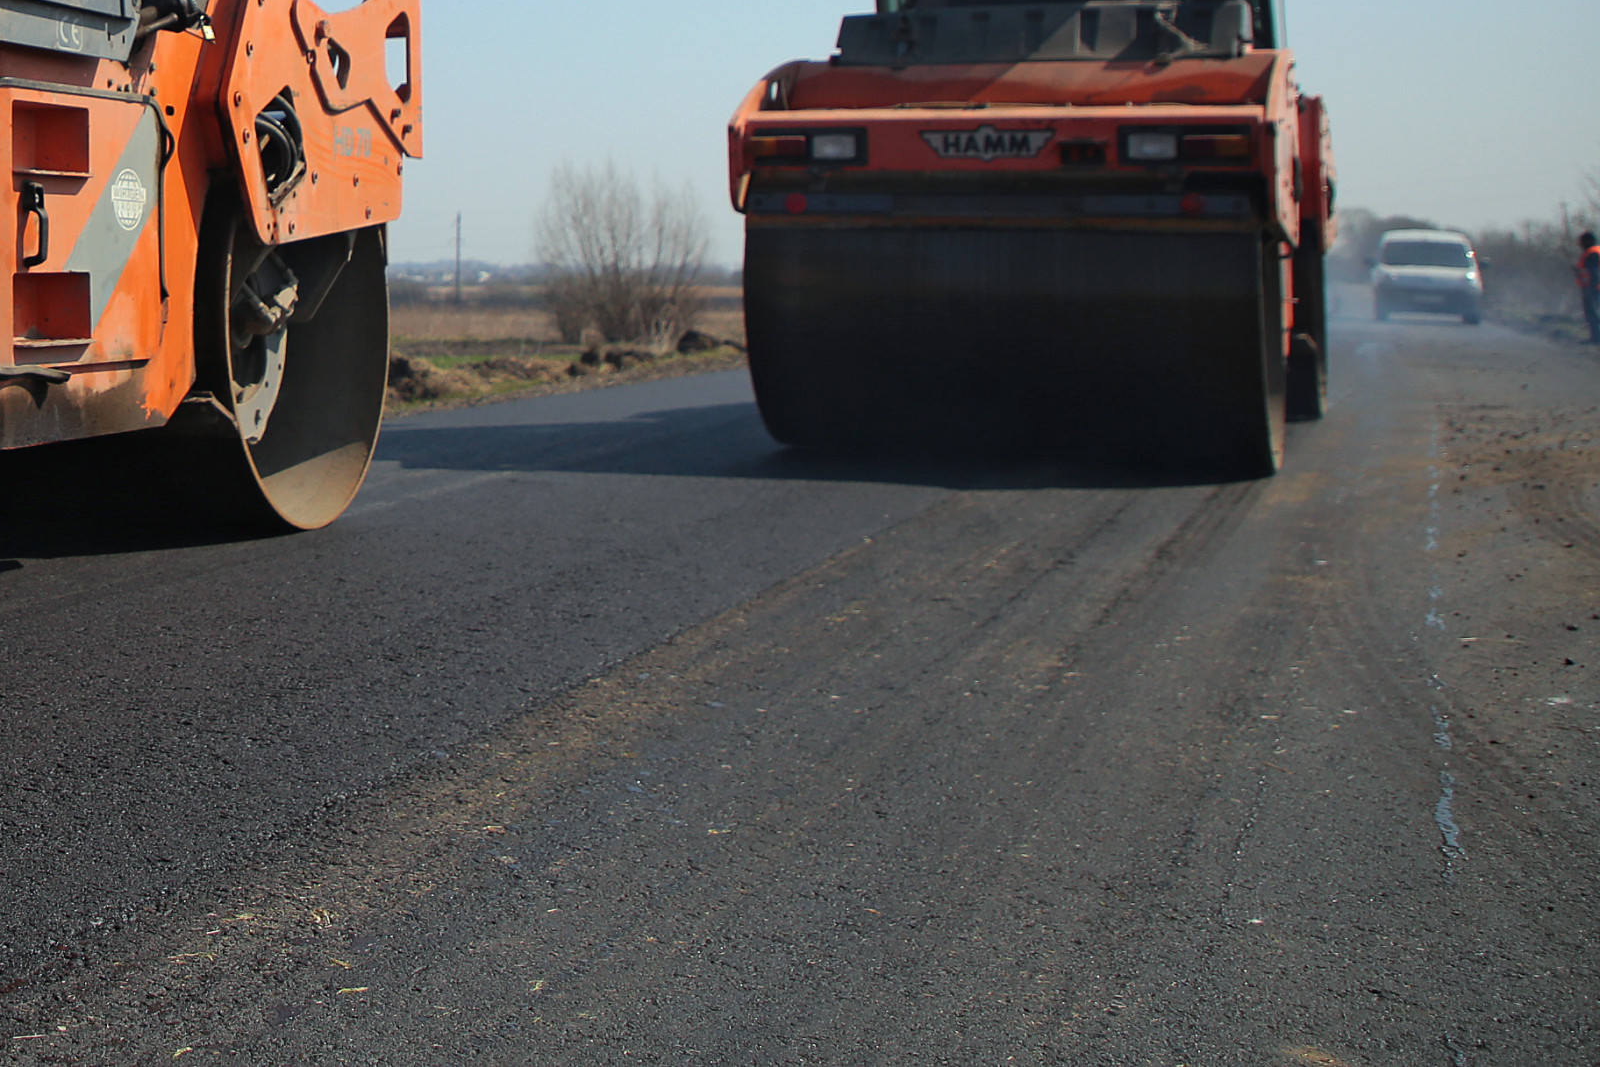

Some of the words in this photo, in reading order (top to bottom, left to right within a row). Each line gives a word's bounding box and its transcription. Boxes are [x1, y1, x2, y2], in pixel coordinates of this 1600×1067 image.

[333, 125, 354, 157] HD
[356, 127, 372, 158] 70
[942, 134, 1032, 154] HAMM
